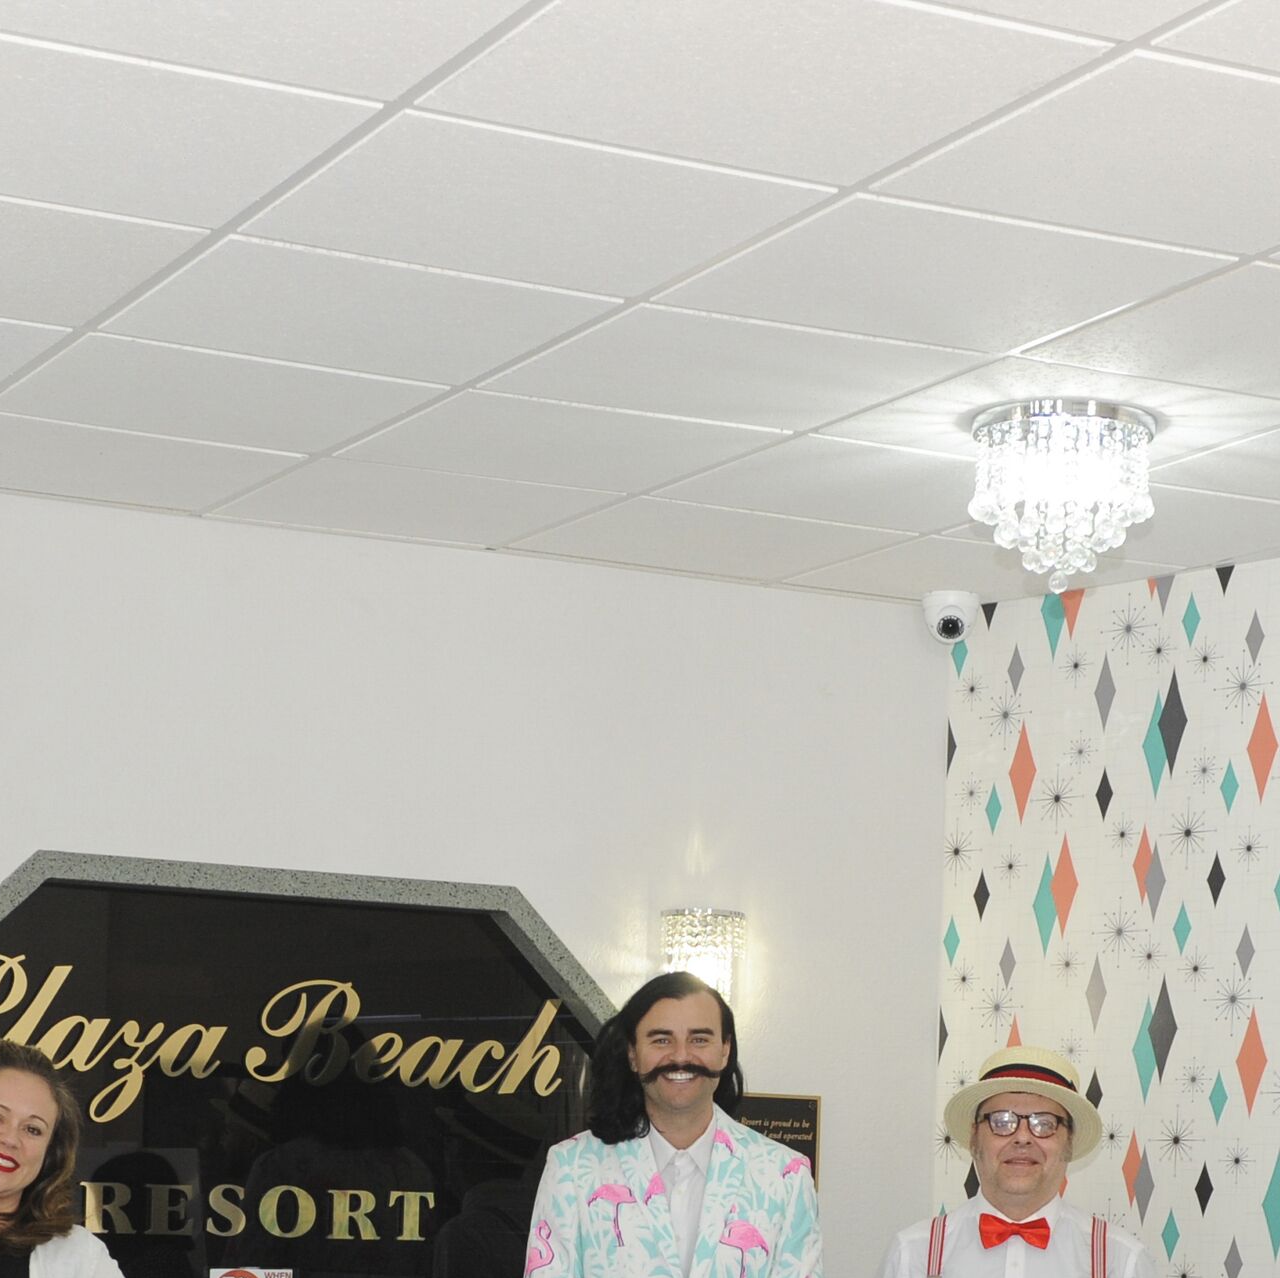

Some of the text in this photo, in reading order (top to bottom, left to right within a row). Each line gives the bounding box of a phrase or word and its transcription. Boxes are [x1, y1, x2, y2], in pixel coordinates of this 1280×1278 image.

[245, 979, 563, 1097] Beach
[770, 1119, 792, 1129] proud
[783, 1131, 814, 1142] operated
[80, 1180, 436, 1242] RESORT
